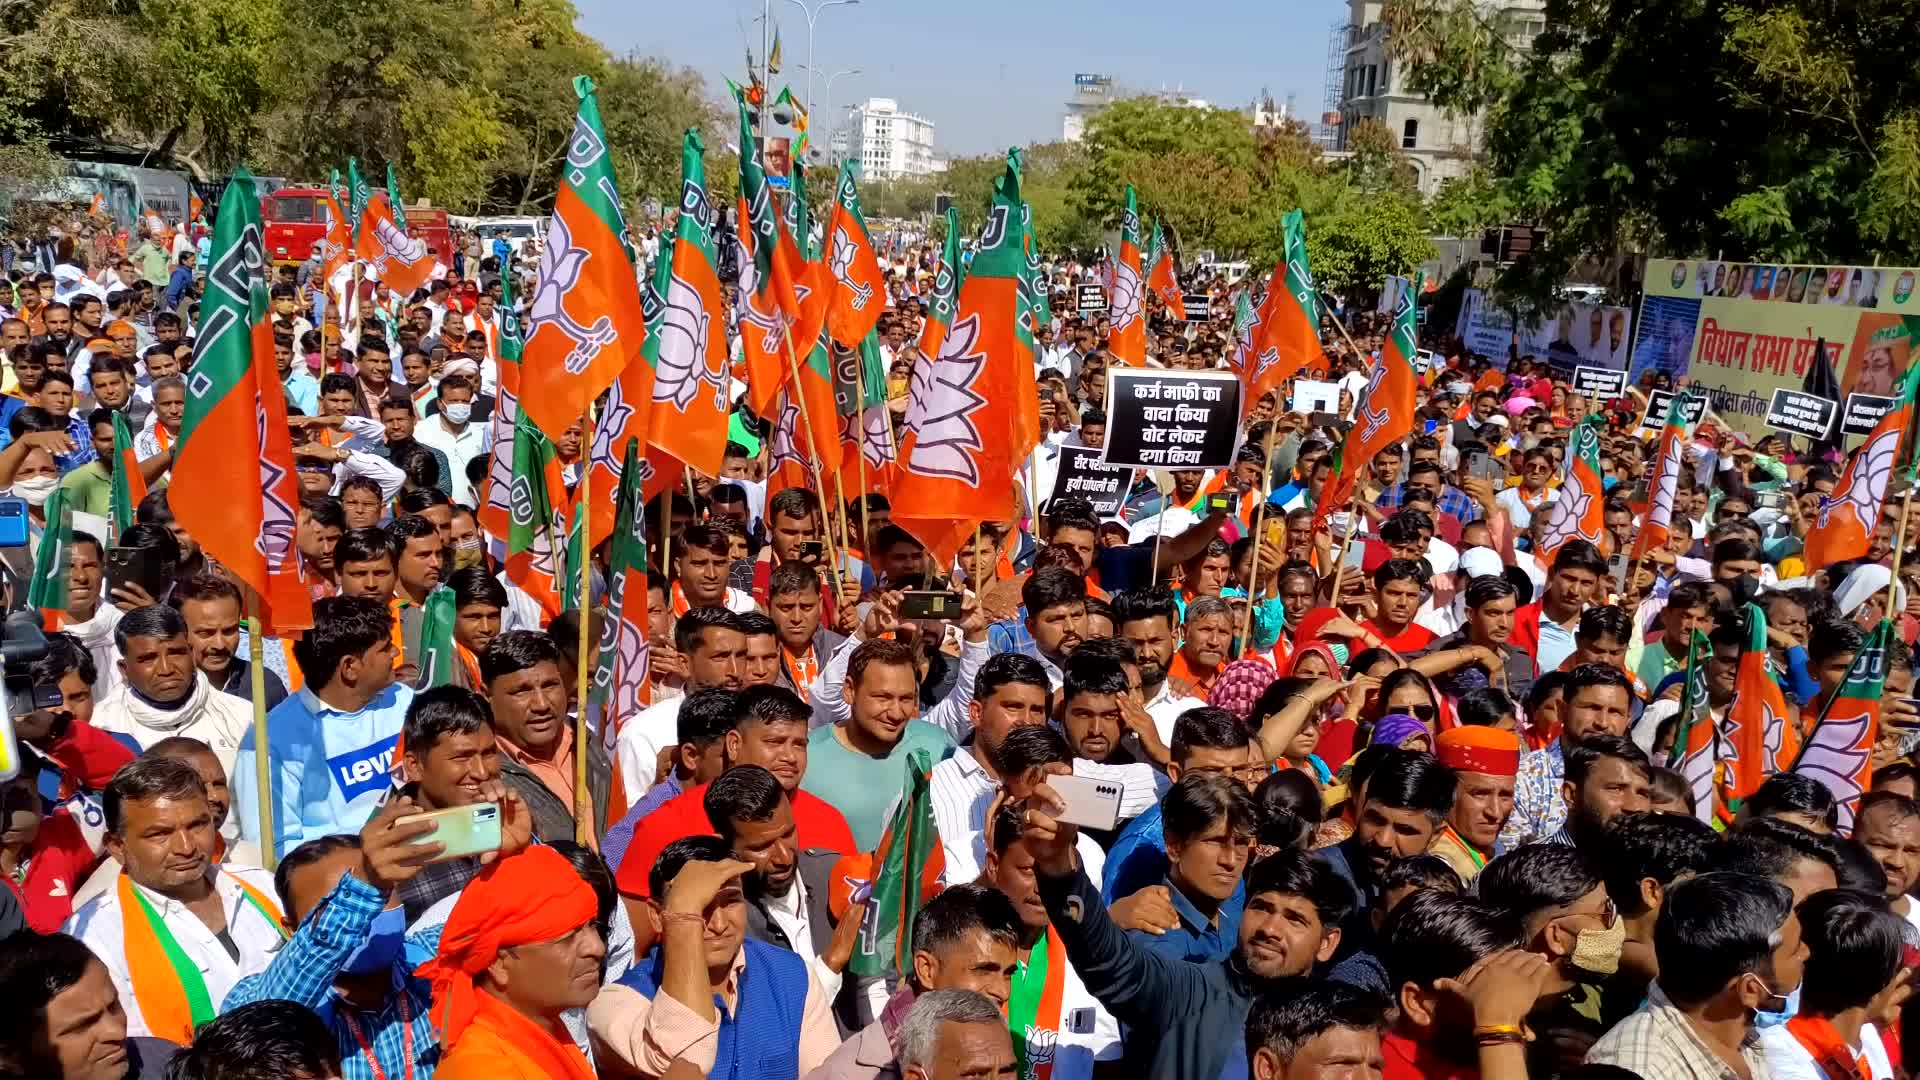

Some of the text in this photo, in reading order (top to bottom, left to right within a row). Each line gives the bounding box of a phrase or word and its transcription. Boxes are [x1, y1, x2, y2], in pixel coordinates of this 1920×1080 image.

[1697, 318, 1752, 369] विधान
[1750, 333, 1794, 377] सभा
[1133, 381, 1222, 402] कर्ज माफी का
[1740, 390, 1770, 416] लीक
[1143, 404, 1210, 423] वादा किया
[1142, 424, 1207, 444] वोट लेकर
[1073, 453, 1089, 470] रीट
[1139, 446, 1203, 464] दगा किया
[1106, 477, 1119, 493] की
